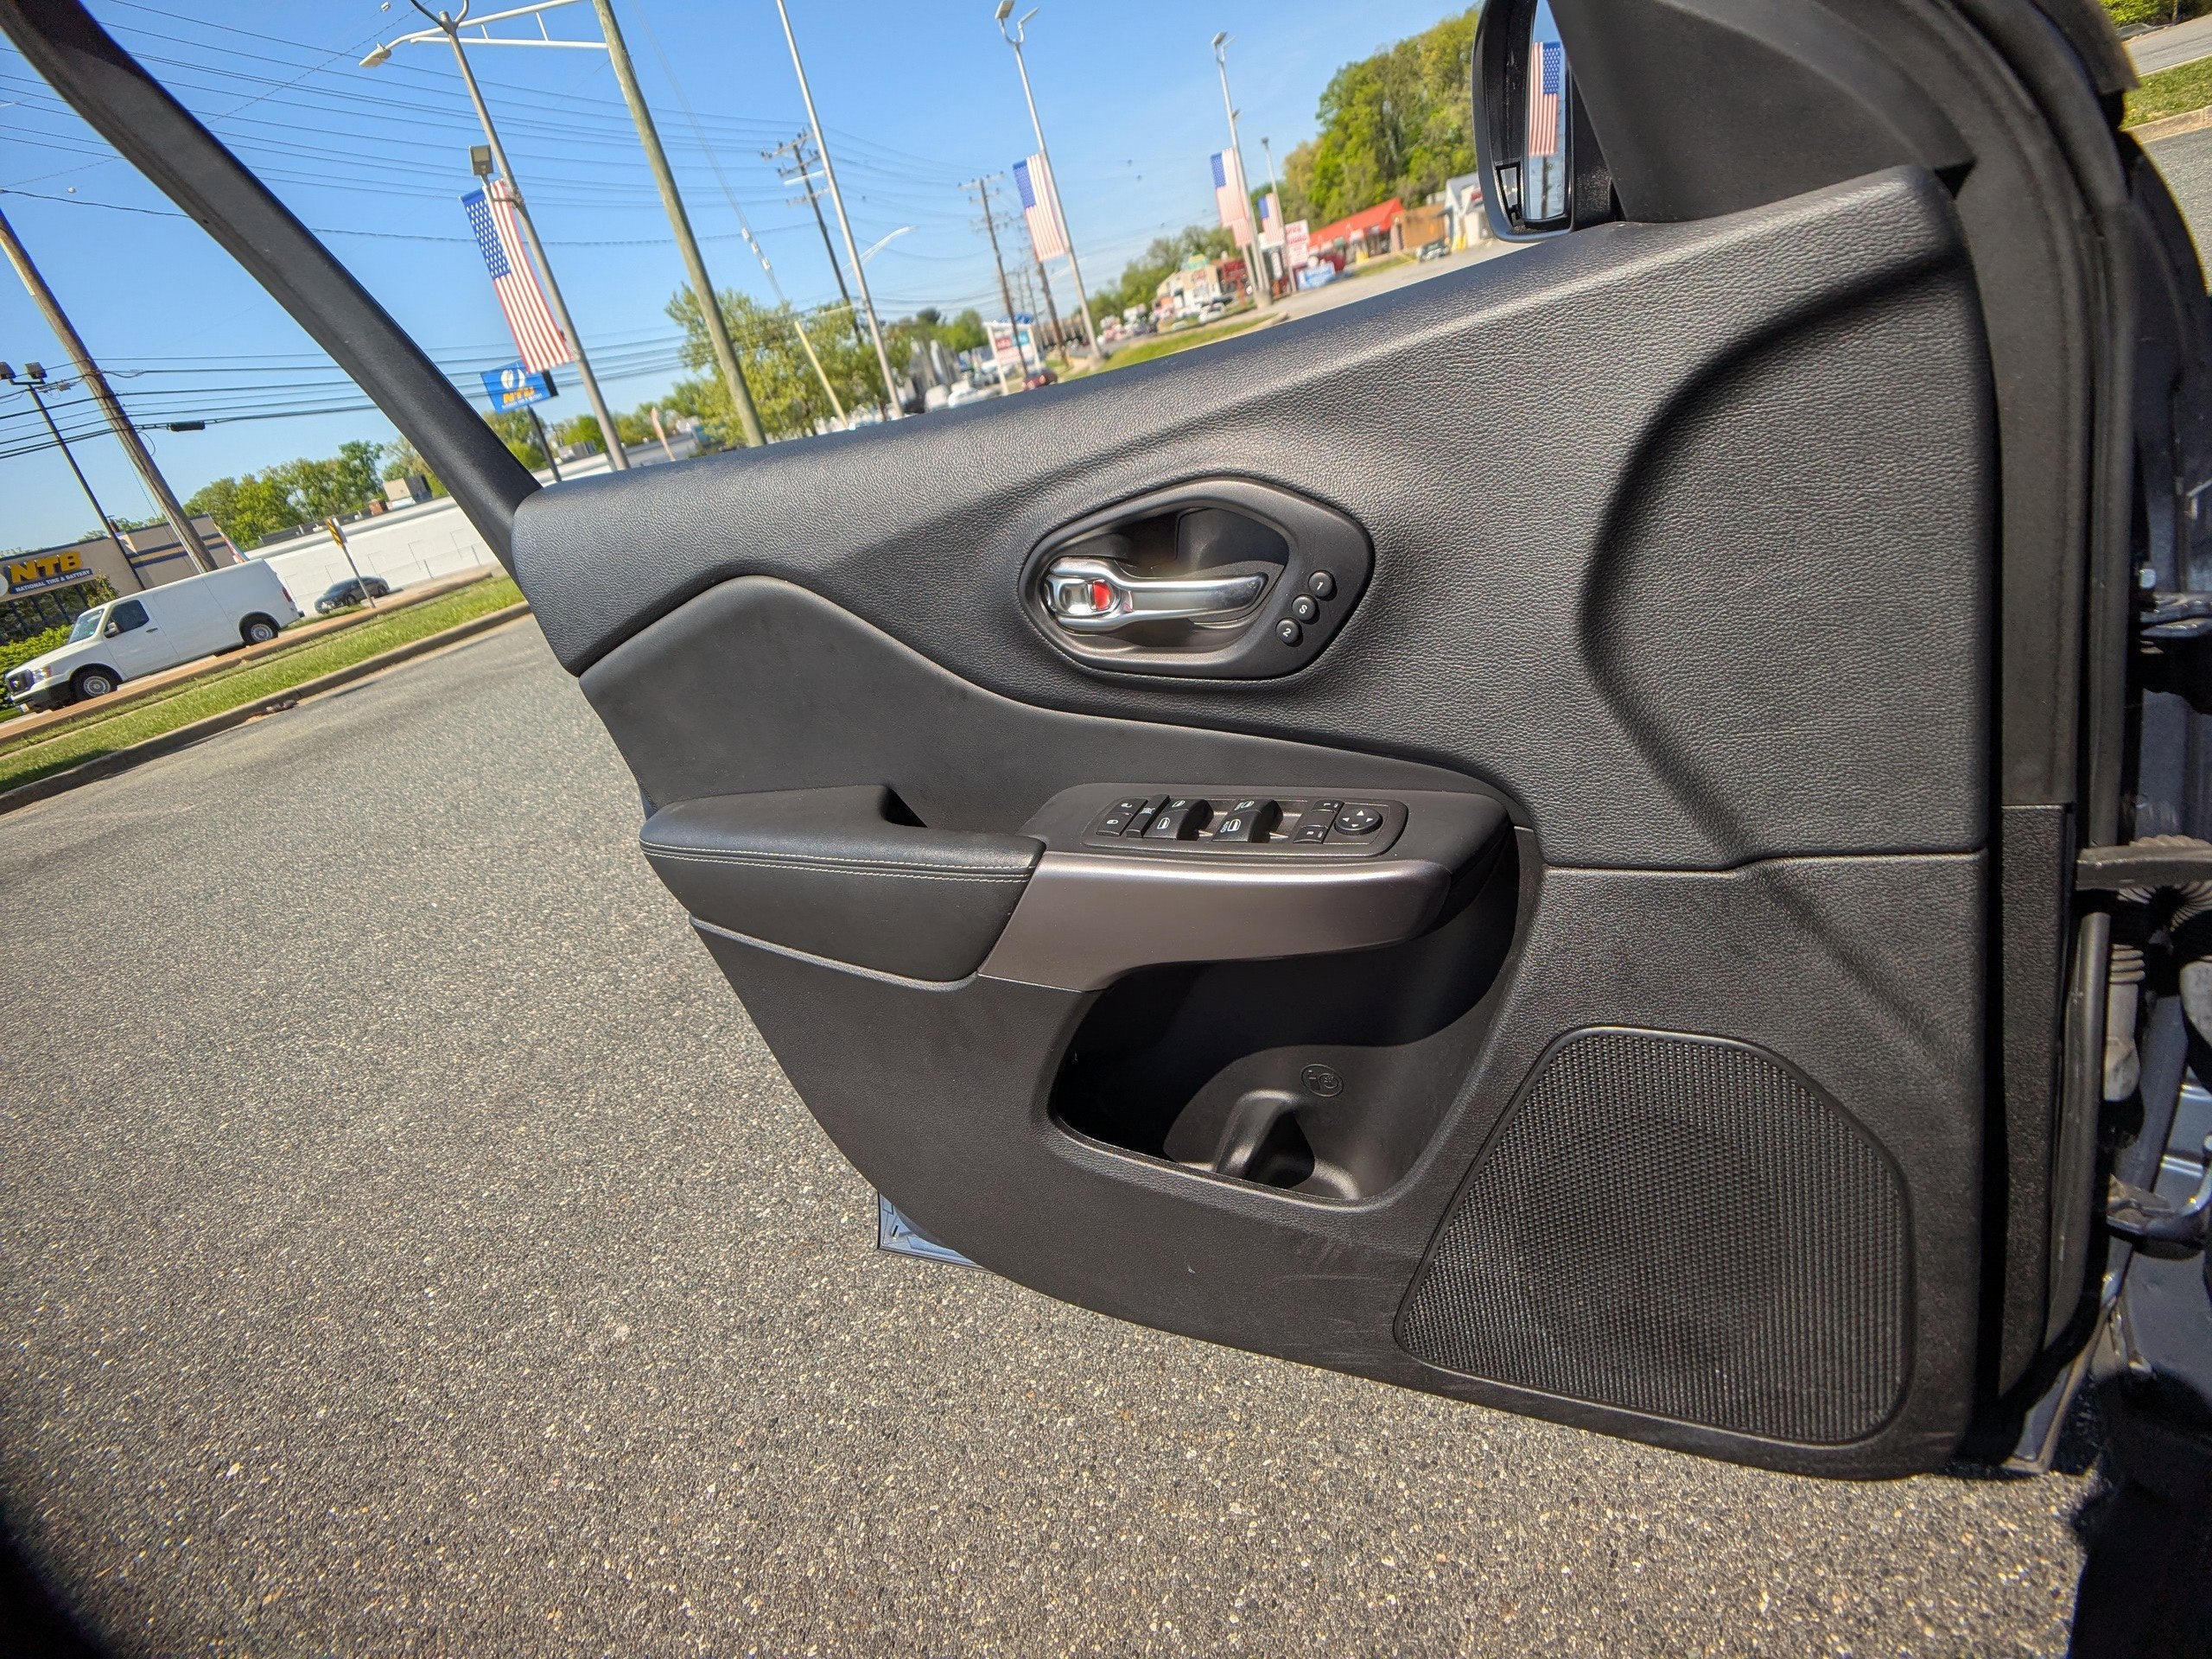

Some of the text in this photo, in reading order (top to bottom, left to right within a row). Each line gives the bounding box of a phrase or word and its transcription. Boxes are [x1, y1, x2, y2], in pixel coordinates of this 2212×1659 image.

[10, 550, 83, 583] NTB
[16, 581, 46, 592] NATIONAL
[46, 576, 60, 585] TIRE
[66, 569, 90, 580] BATTERY
[1317, 582, 1324, 590] 1
[1299, 604, 1307, 614] S
[1282, 627, 1292, 637] 2
